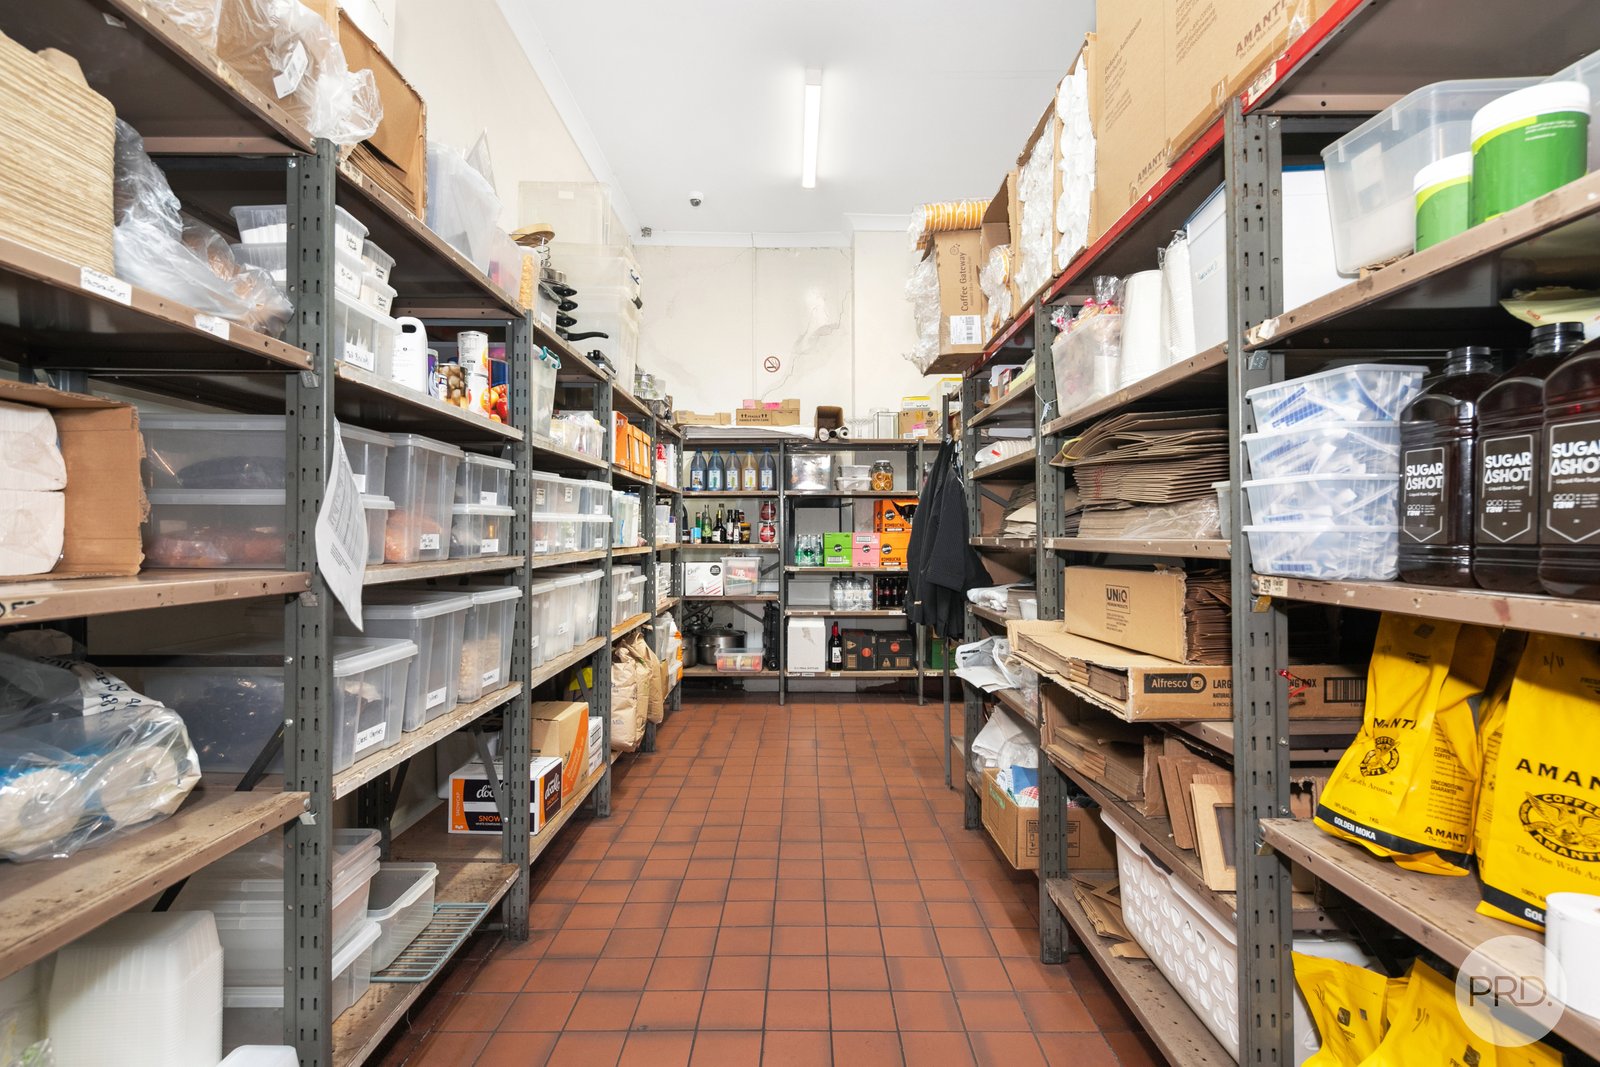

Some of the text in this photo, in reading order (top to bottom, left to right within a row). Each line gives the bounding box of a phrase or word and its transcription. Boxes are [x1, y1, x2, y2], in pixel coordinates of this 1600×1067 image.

[961, 286, 969, 312] Coffee
[1485, 451, 1532, 469] SUGAR
[1560, 456, 1600, 475] SHO
[1406, 462, 1443, 477] SUGAR
[1151, 677, 1188, 689] Alfresco
[1333, 816, 1377, 841] GOLDEN MOKA
[1424, 826, 1468, 844] AMANTI
[1515, 844, 1531, 857] The
[1533, 851, 1553, 865] One
[1555, 859, 1583, 876] With
